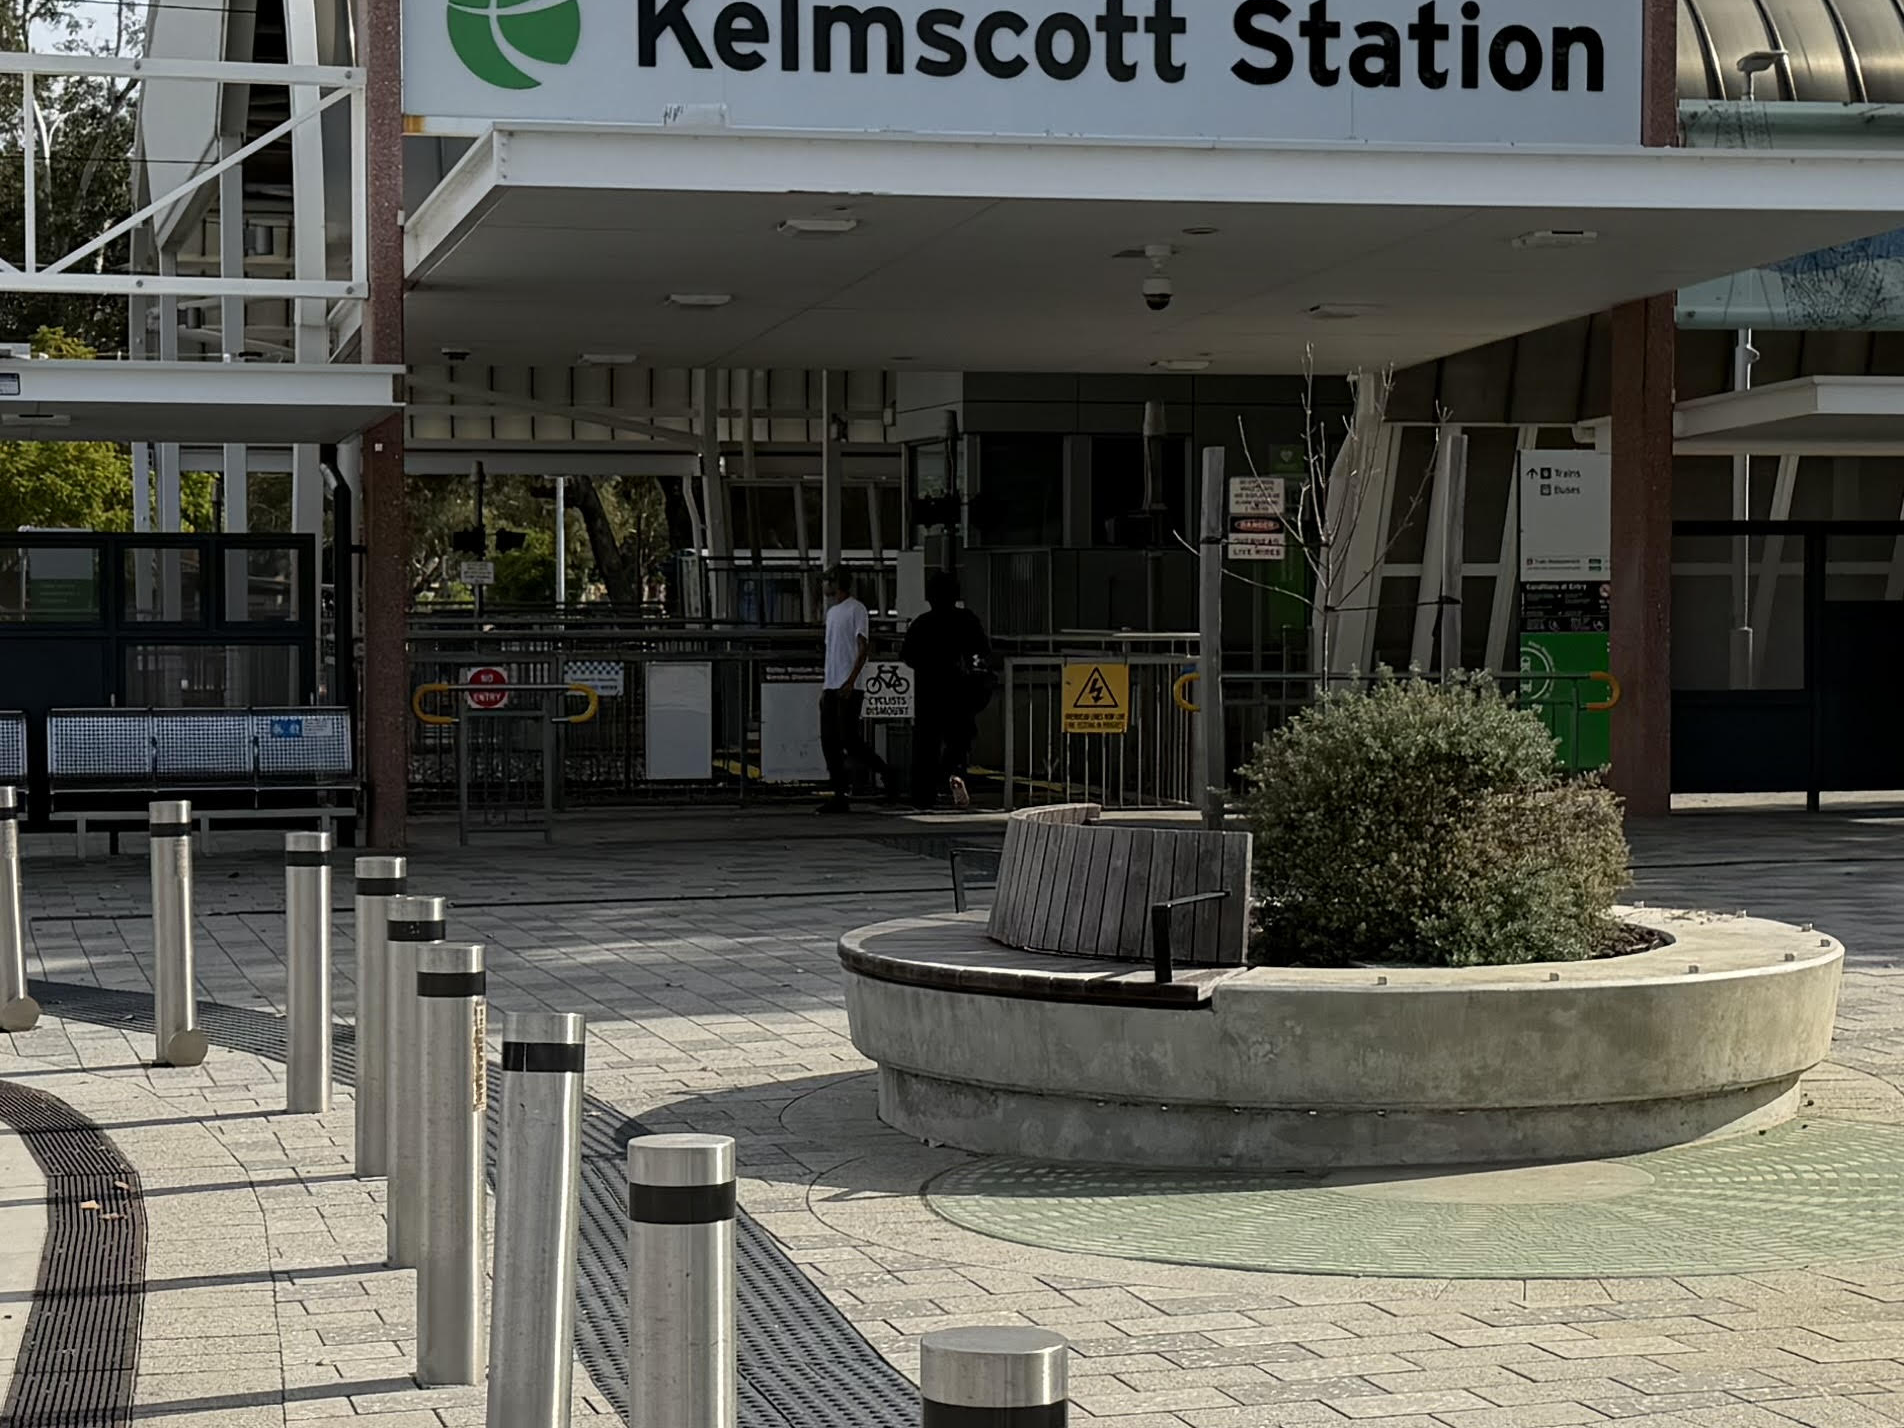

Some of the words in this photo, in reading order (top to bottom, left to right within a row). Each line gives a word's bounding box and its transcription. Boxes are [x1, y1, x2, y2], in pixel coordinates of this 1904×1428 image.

[1554, 468, 1581, 478] Trains
[1554, 486, 1581, 495] Buses
[1526, 583, 1559, 591] Conditions
[1568, 583, 1587, 592] Entry
[480, 673, 494, 683] NO
[473, 692, 502, 702] ENTRY
[868, 696, 907, 706] CYCLISTS
[865, 706, 909, 716] DISMOUNT
